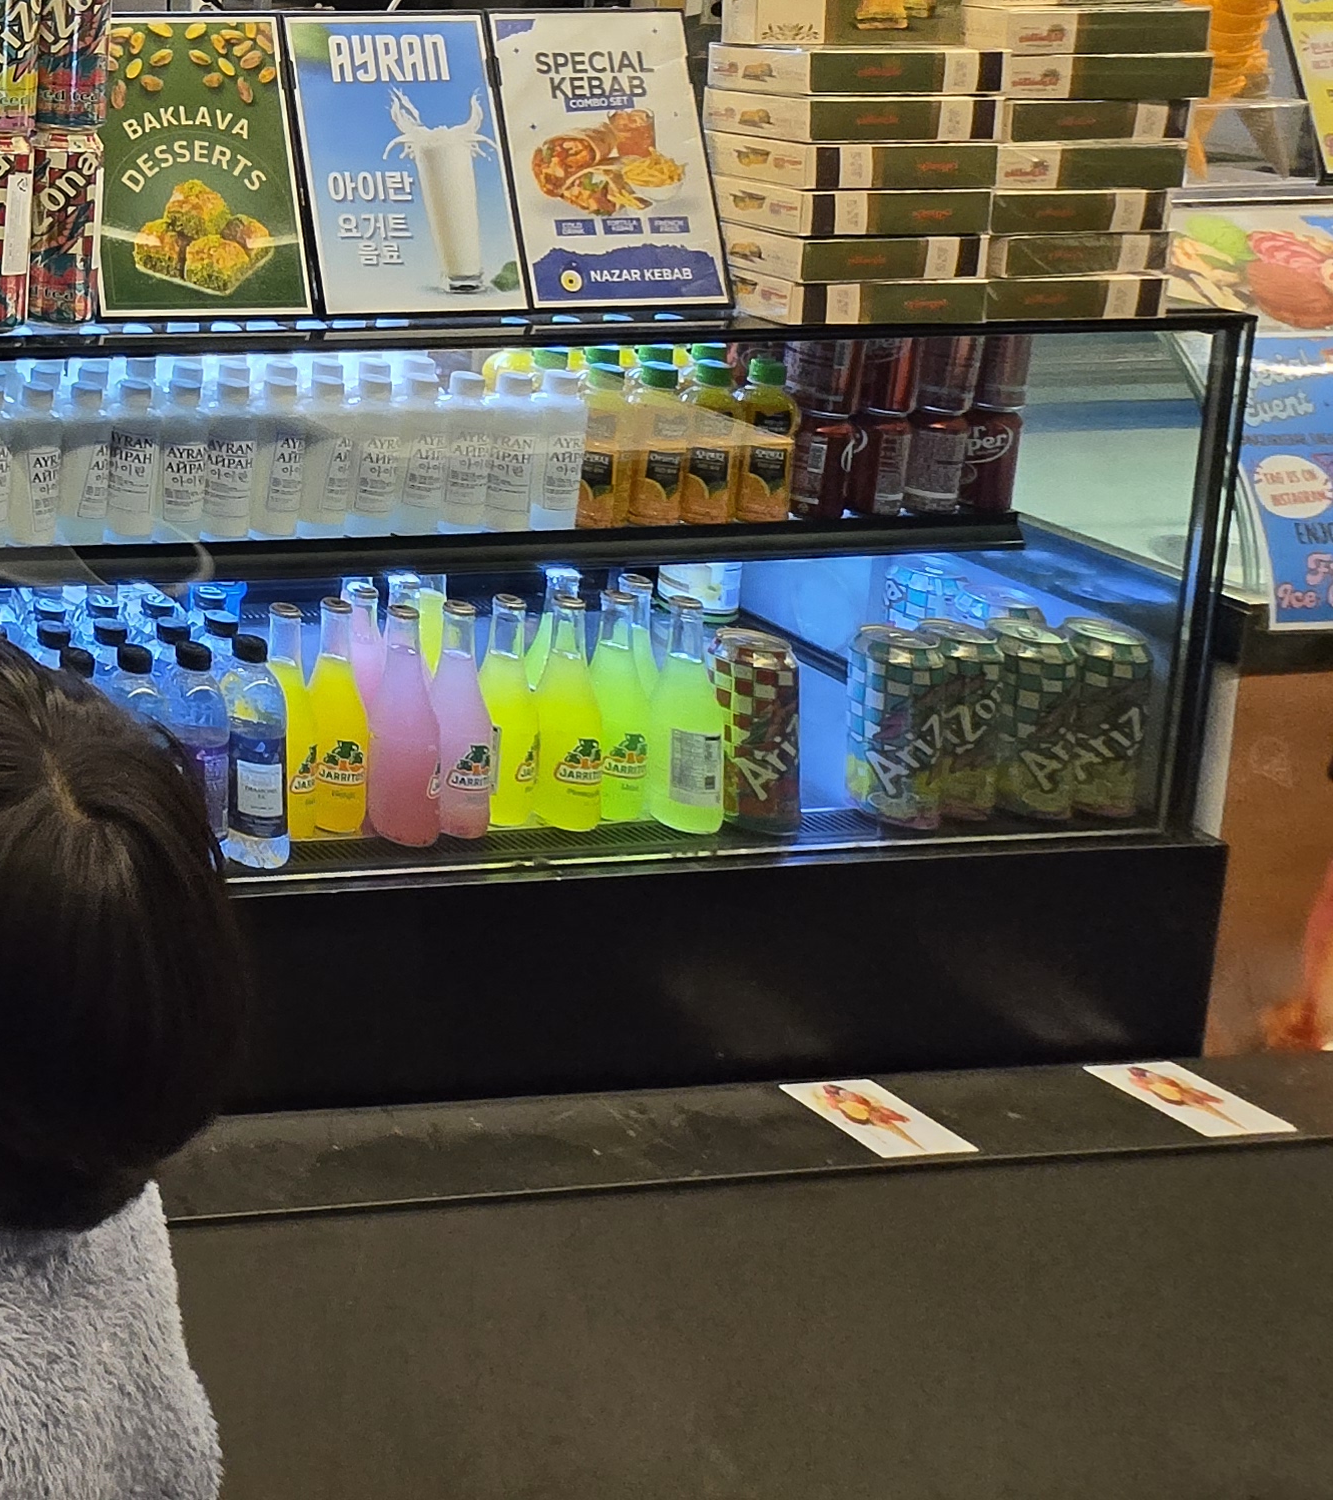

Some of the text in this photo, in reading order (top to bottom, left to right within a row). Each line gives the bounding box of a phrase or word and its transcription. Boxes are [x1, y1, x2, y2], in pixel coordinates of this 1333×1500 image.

[329, 33, 451, 83] AYRAN
[535, 50, 654, 77] SPECIAL
[550, 76, 647, 98] KEBAB
[569, 98, 630, 110] COMBO SET
[122, 107, 250, 140] BAKLAVA
[121, 140, 267, 193] DESSERTS
[328, 170, 413, 204] 아이란
[337, 213, 412, 240] 요거트
[357, 241, 404, 267] 음료
[590, 268, 693, 282] NAZAR KEBAB
